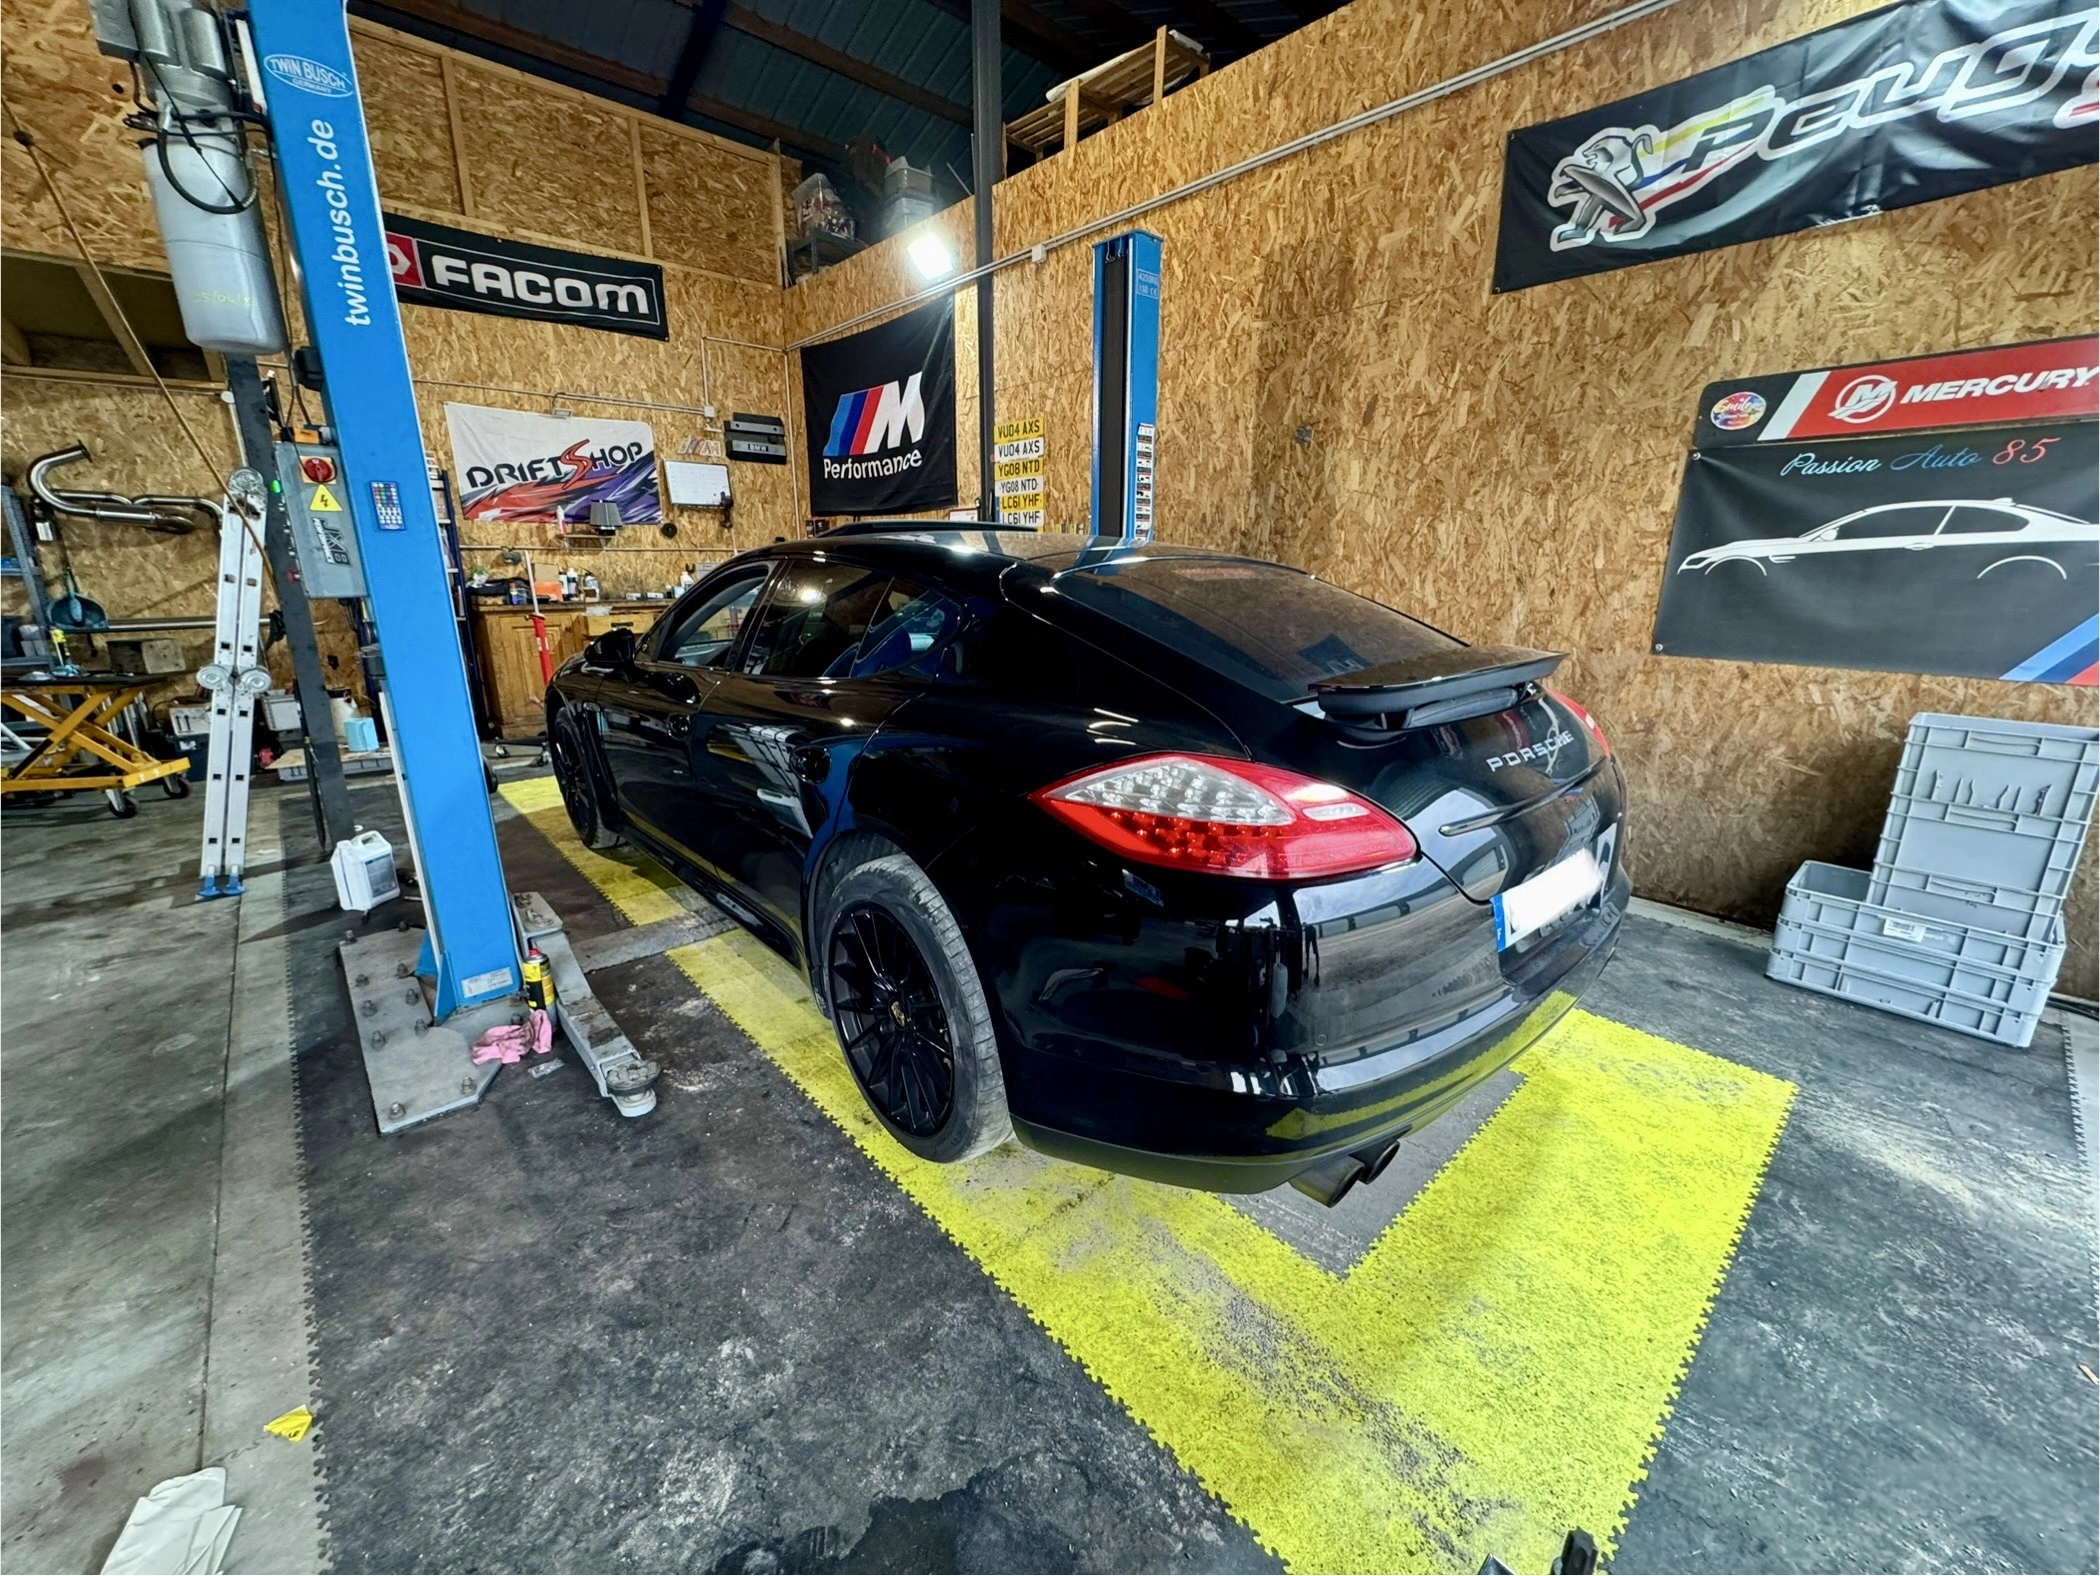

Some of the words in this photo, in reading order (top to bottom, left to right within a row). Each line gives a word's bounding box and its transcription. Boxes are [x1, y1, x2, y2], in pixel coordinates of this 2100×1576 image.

[269, 59, 302, 77] TWIN
[302, 62, 346, 89] BUSCH
[292, 77, 332, 94] GERMANY
[307, 119, 371, 326] twinbusch.de
[1900, 366, 2099, 404] MERCURY
[863, 371, 926, 455] M
[998, 424, 1020, 439] VU04
[1022, 420, 1040, 435] AXS
[749, 443, 768, 452] BMW
[998, 443, 1020, 458] VU04
[1022, 440, 1040, 455] AXS
[823, 449, 923, 479] Performance
[1780, 452, 1883, 477] Passion
[1890, 444, 1983, 471] Auto
[1992, 437, 2061, 465] 85
[998, 462, 1020, 477] YG08
[1022, 459, 1040, 474] NTD
[1001, 481, 1019, 494] YG08
[1021, 478, 1038, 492] NTD
[1022, 493, 1040, 507] YHF
[1022, 510, 1040, 524] YHF
[1486, 730, 1574, 773] PORSCHE
[1497, 927, 1502, 940] F
